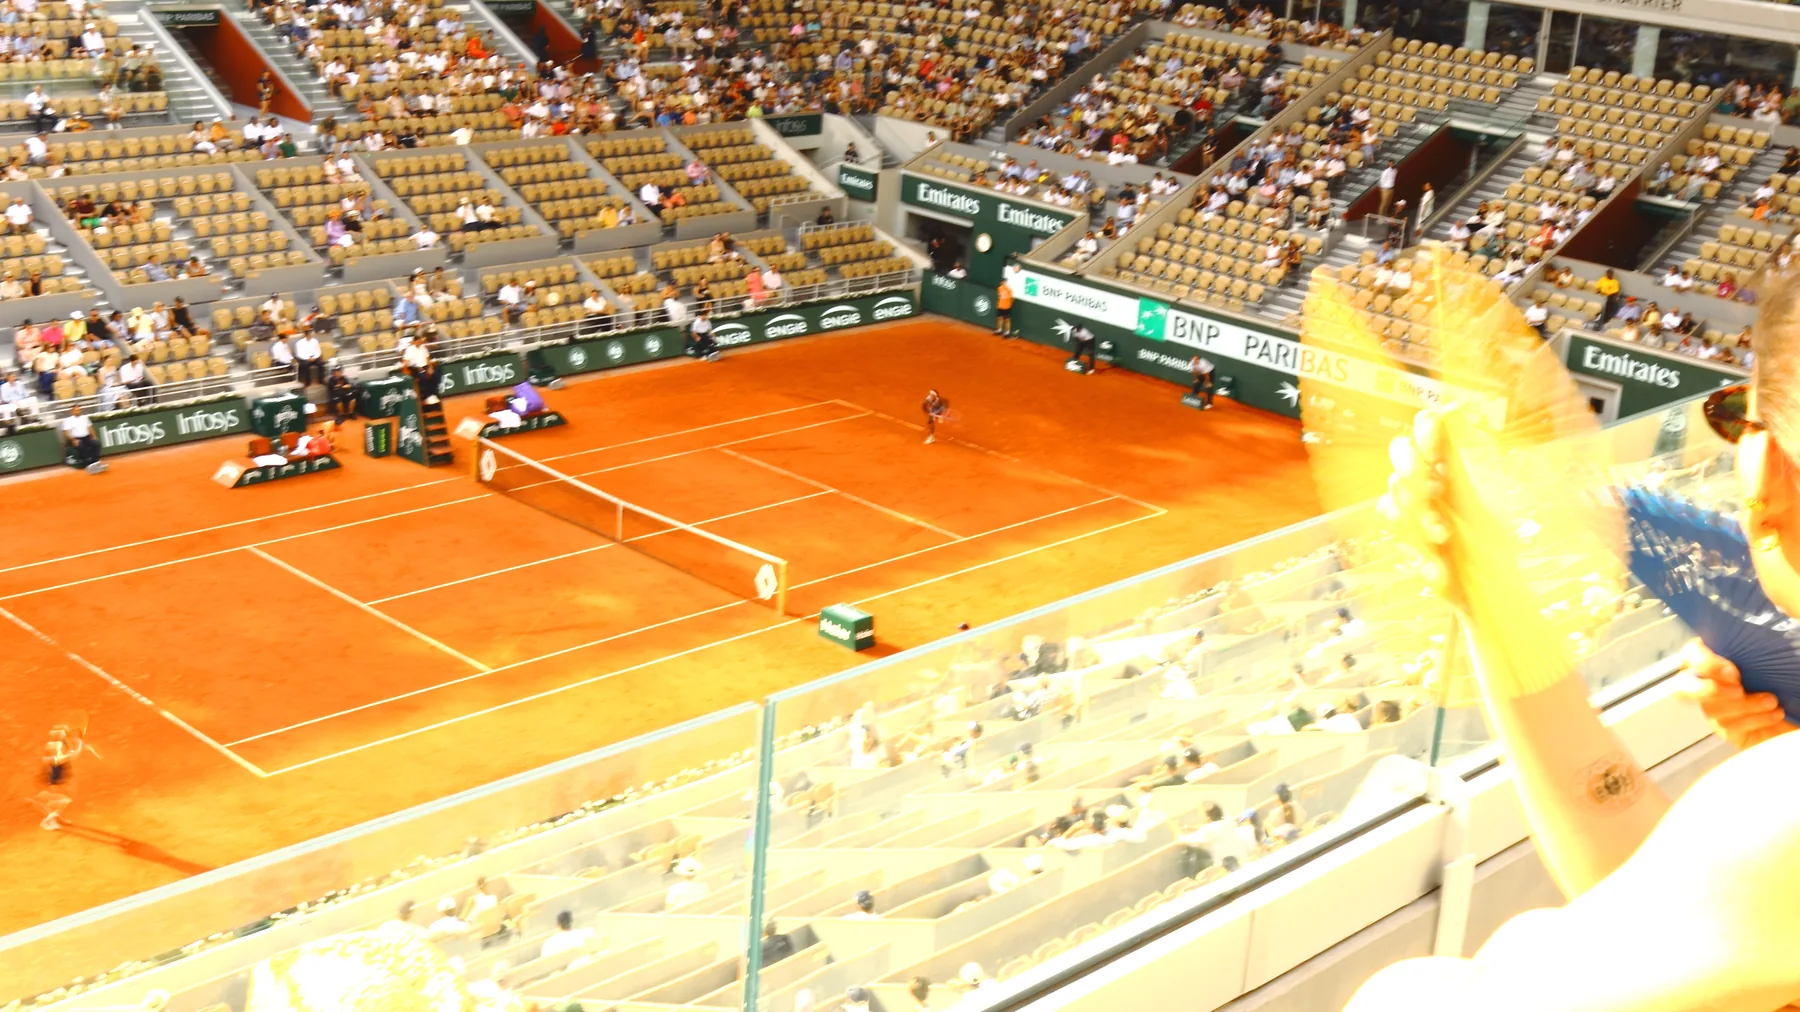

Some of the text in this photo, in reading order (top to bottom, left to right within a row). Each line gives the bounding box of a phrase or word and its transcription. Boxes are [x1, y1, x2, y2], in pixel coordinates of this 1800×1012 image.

[840, 173, 874, 190] Emirates
[917, 182, 981, 215] Emirates
[998, 203, 1064, 234] Emirates
[1042, 285, 1108, 312] BNP PARIBAS
[1172, 315, 1349, 383] BNP PARIBAS
[461, 363, 516, 386] Infosys
[1157, 354, 1194, 374] PARIBA
[1581, 344, 1681, 389] Emirates
[101, 420, 165, 448] Infosys
[175, 408, 240, 435] Infosys
